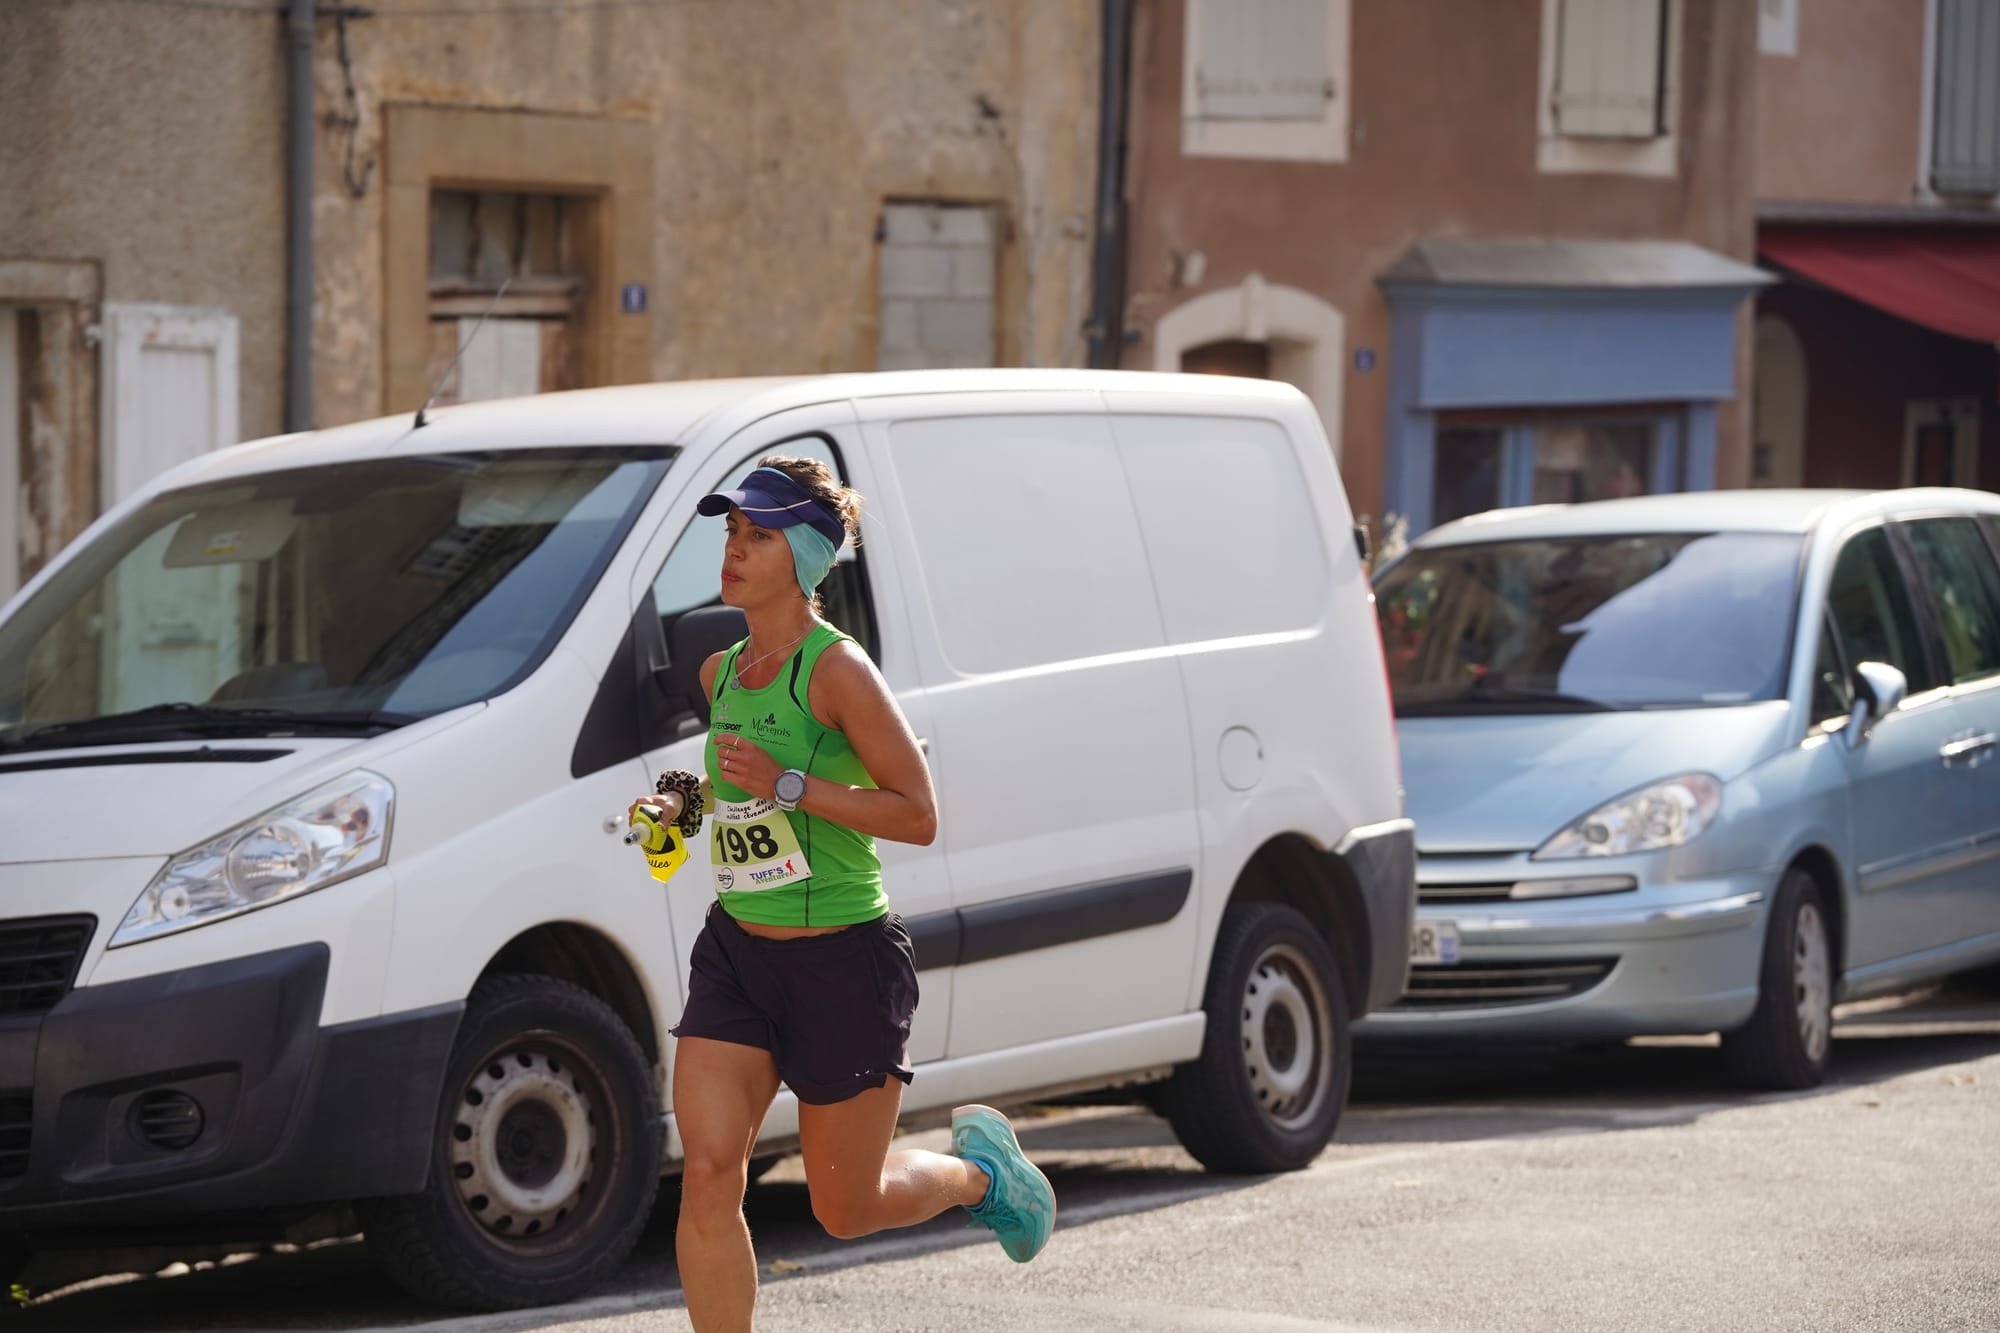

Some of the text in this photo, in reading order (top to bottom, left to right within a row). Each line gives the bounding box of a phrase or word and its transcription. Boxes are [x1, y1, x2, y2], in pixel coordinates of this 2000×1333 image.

[750, 717, 791, 737] Marvejols
[716, 825, 779, 863] 198
[749, 867, 784, 880] TUFF'S
